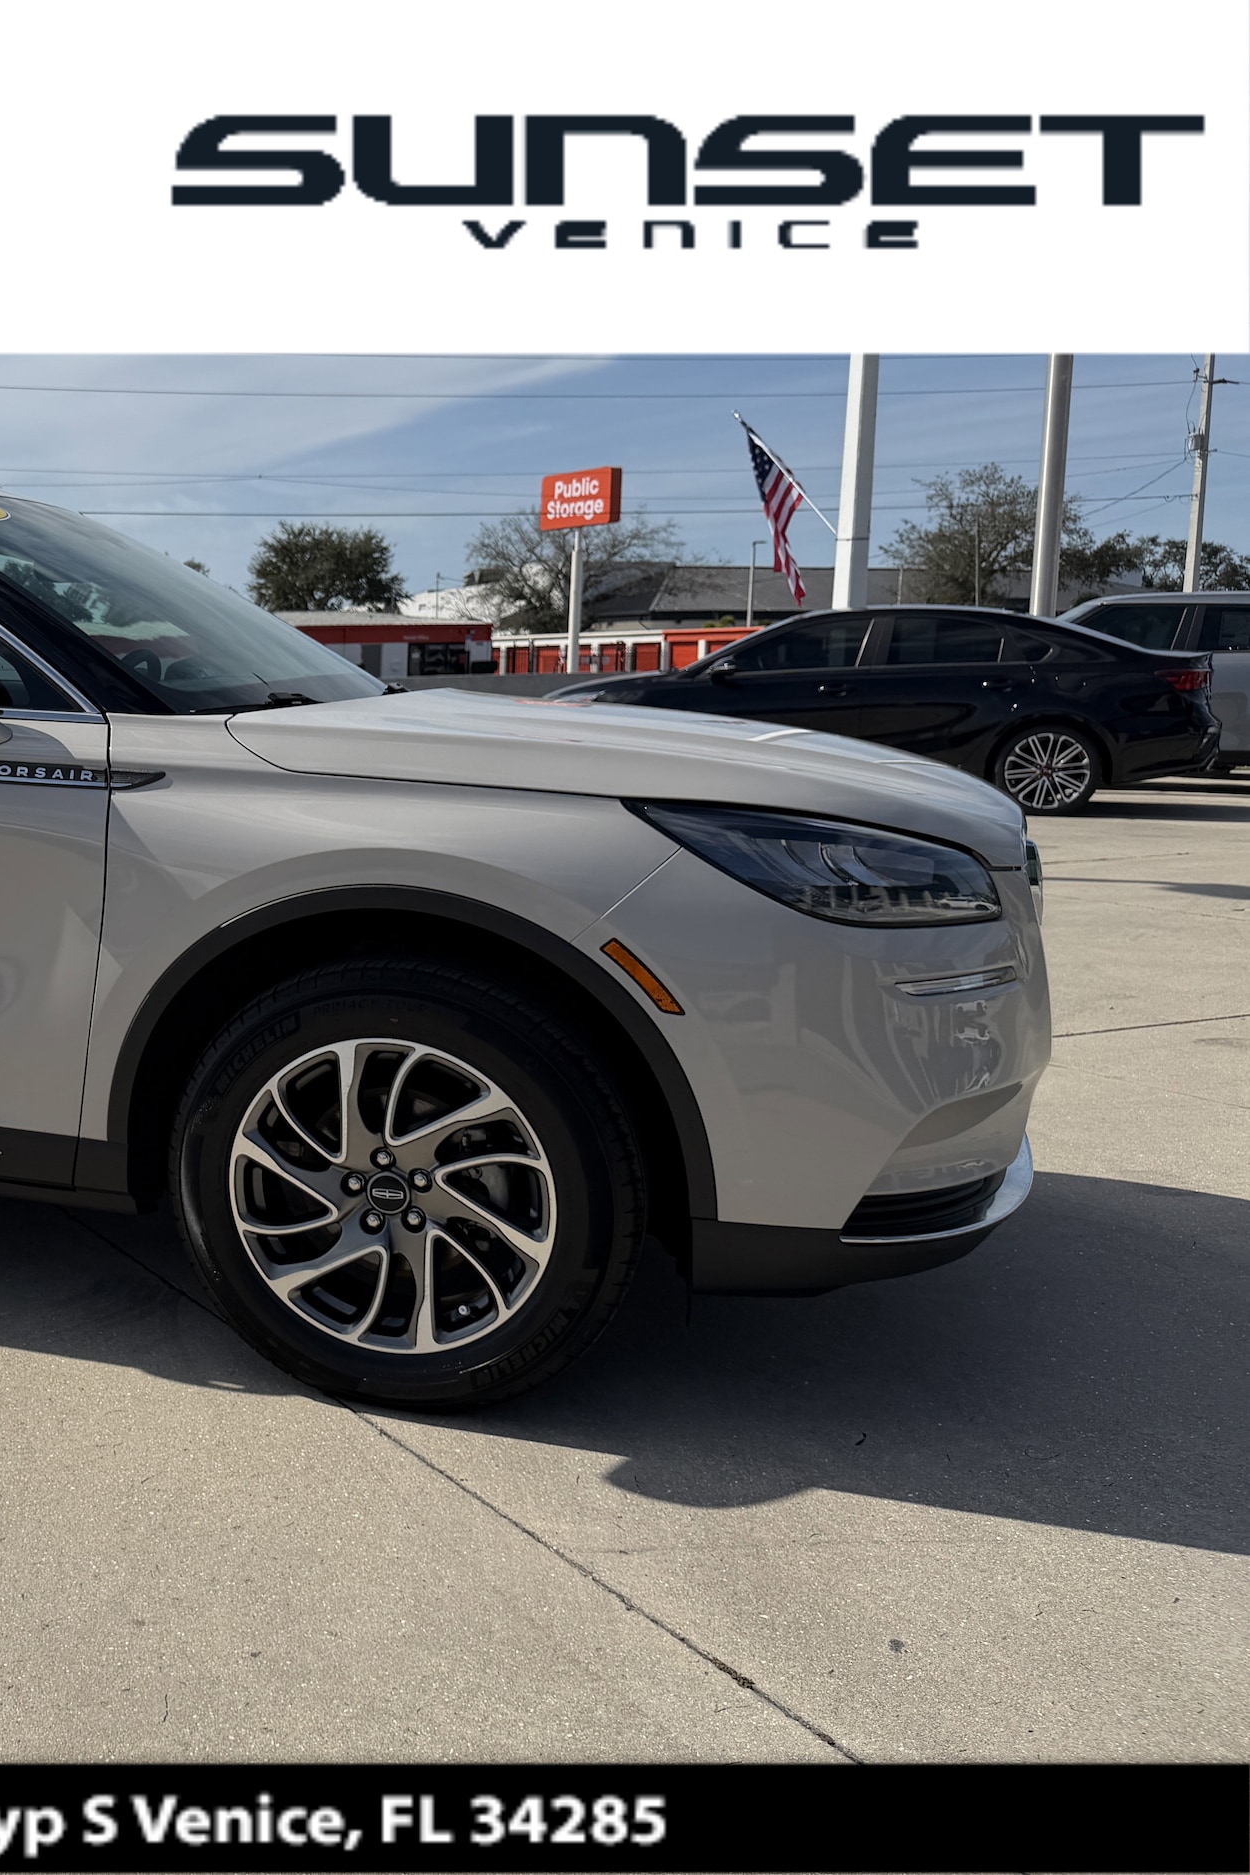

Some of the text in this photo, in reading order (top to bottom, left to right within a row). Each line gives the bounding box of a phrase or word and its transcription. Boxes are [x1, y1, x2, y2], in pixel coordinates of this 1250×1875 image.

[554, 477, 599, 500] Public
[546, 499, 604, 520] Storage
[213, 1014, 300, 1096] MICHELIN
